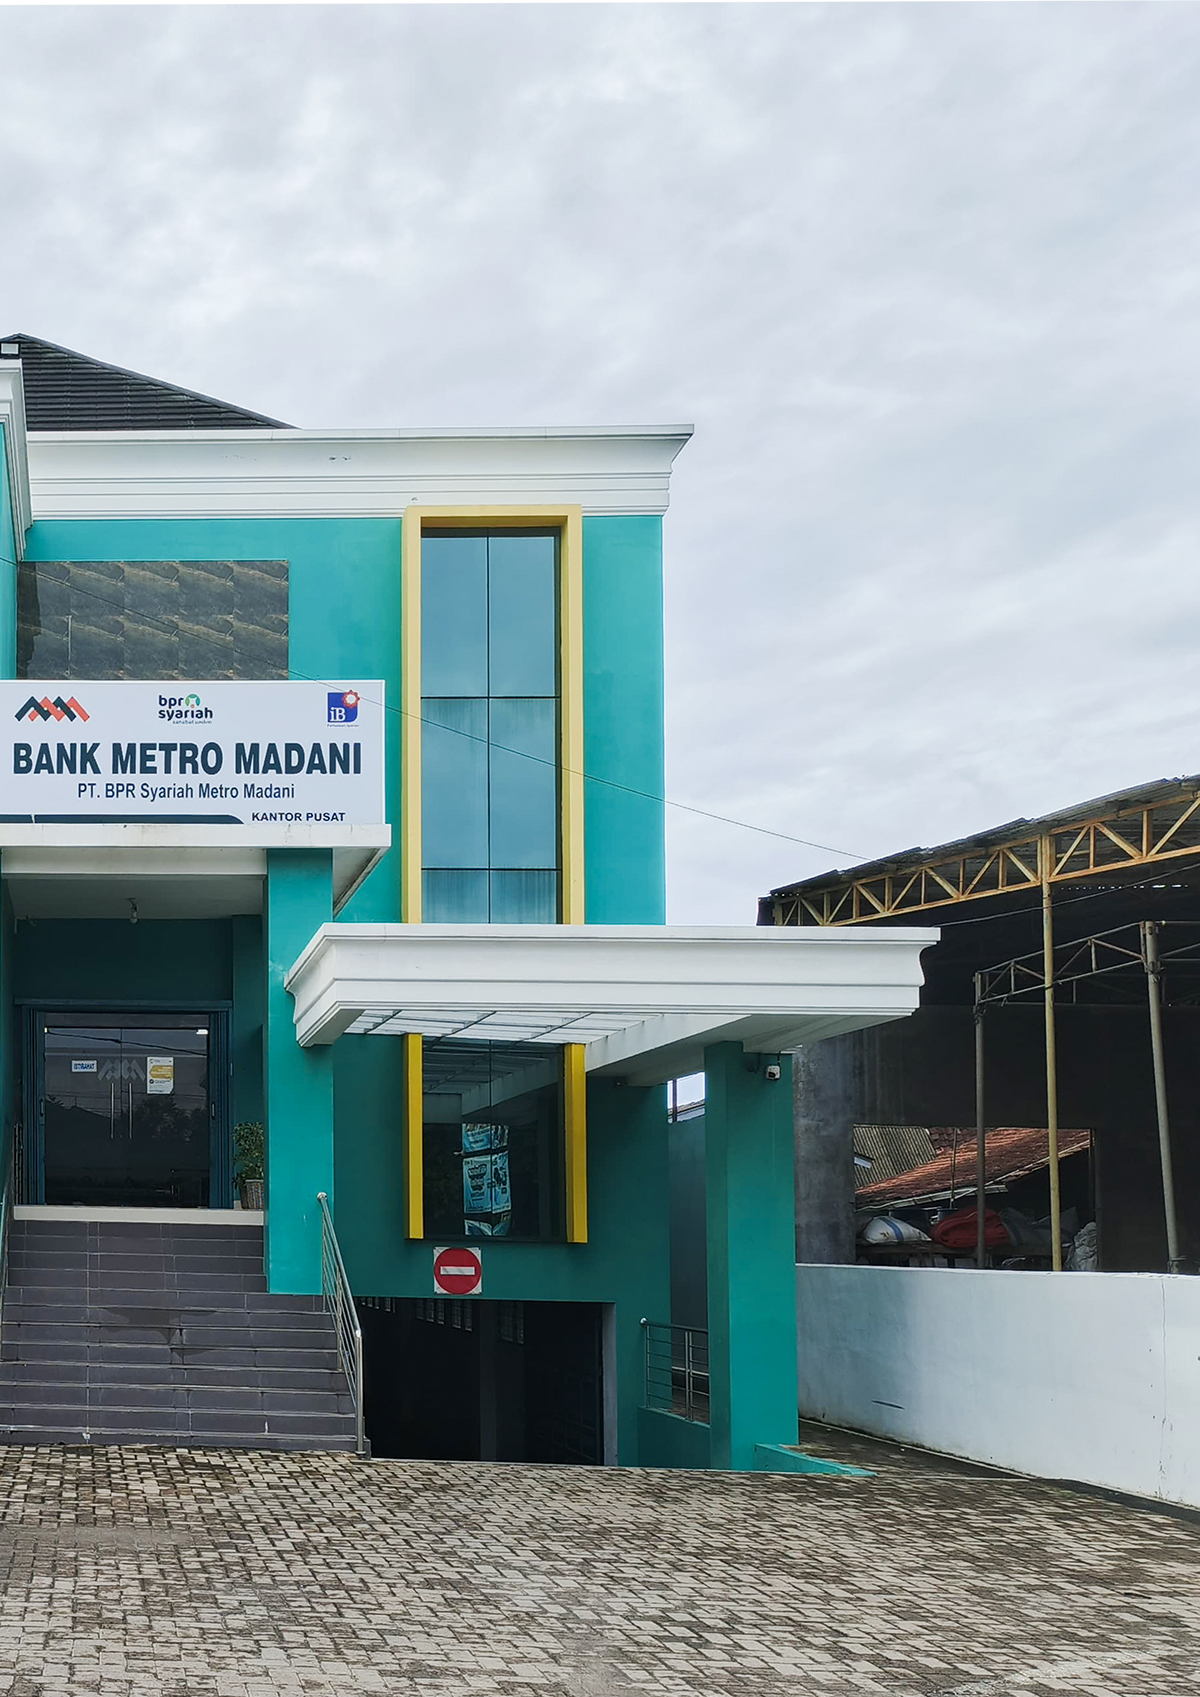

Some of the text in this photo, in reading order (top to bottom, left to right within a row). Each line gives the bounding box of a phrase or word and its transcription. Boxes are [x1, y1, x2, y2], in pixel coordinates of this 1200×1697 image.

[159, 695, 184, 709] bpr
[158, 706, 213, 721] syariah
[329, 706, 346, 721] iB
[13, 741, 362, 775] BANK METRO MADANI
[78, 783, 295, 803] PT. BPR Syariah Metro Madani
[251, 812, 346, 822] KANTOR PUSAT
